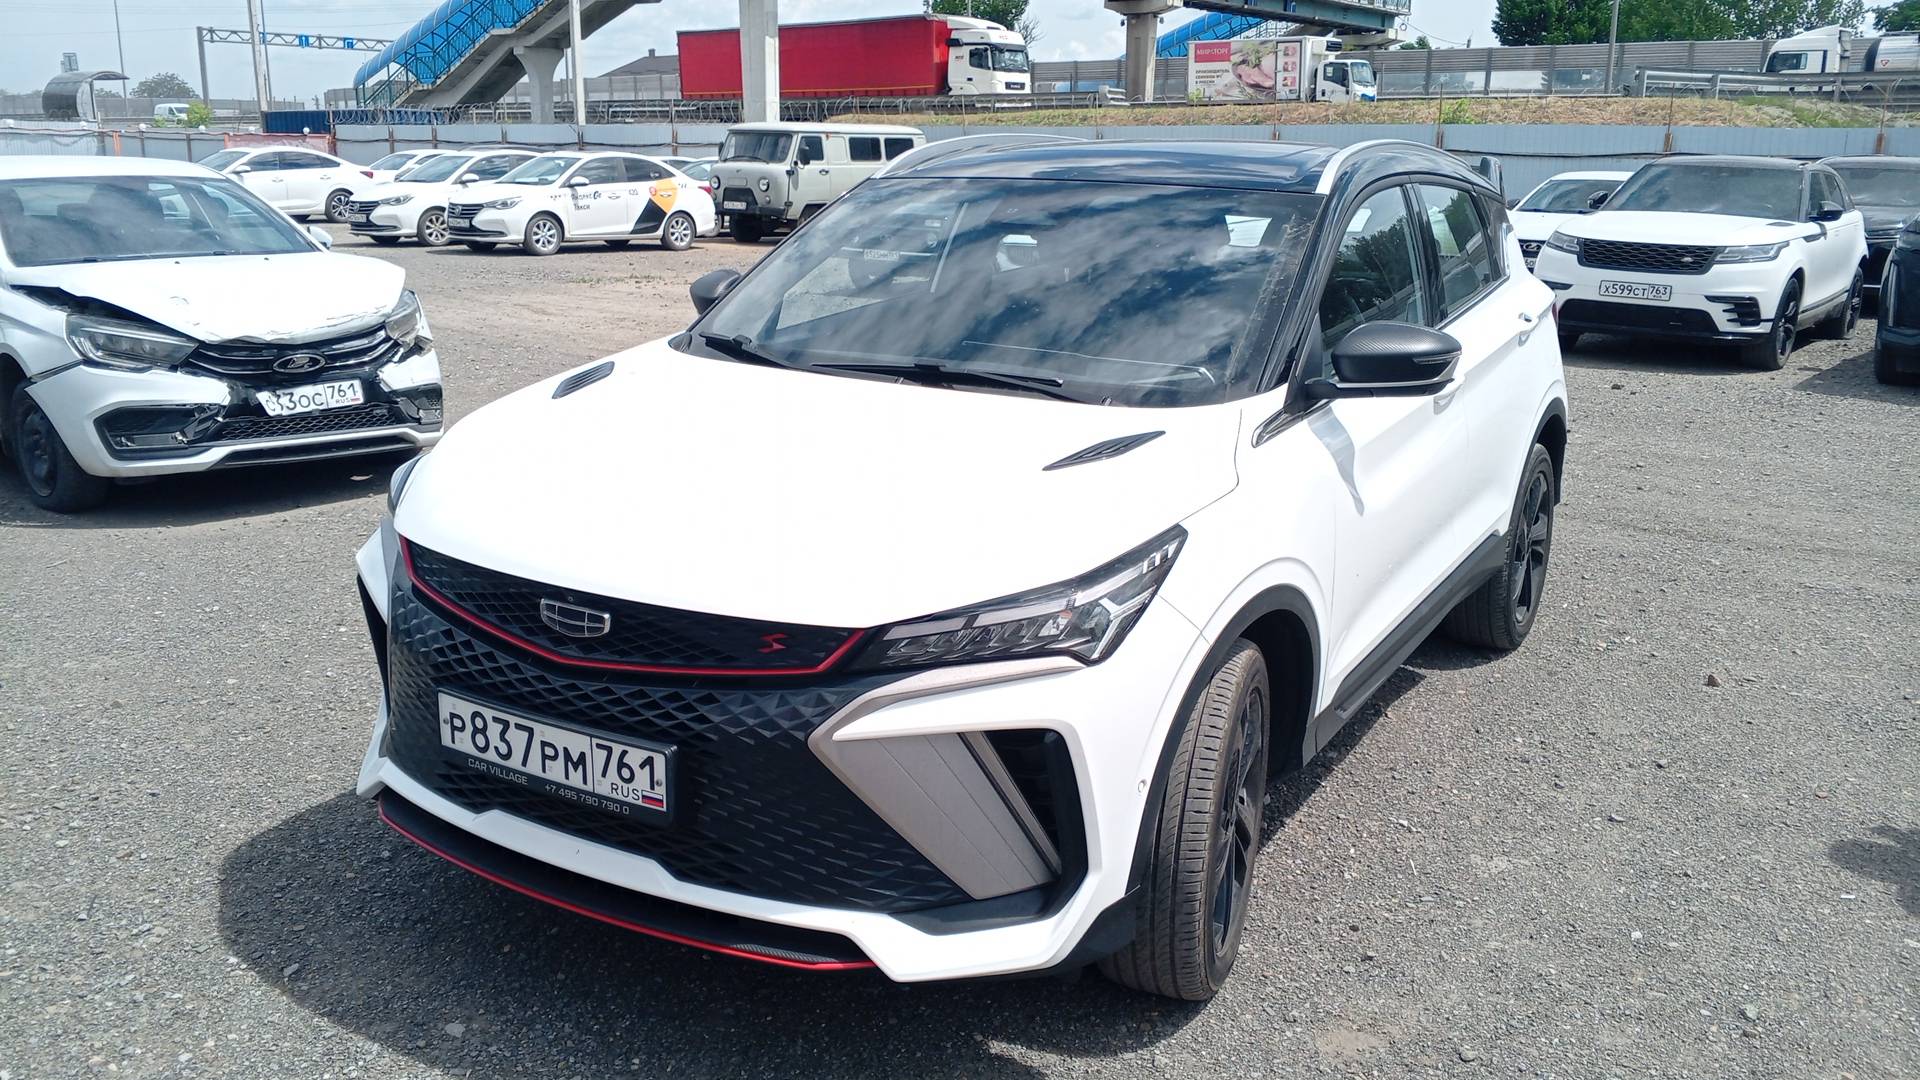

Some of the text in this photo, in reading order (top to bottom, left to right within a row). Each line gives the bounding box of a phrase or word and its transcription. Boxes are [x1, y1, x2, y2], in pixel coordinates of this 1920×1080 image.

[1650, 285, 1668, 296] 763
[326, 382, 358, 400] 761
[467, 758, 529, 786] CAR VILLAGE
[595, 742, 656, 791] 761
[544, 783, 556, 794] +7
[558, 788, 578, 800] 495
[579, 793, 599, 807] 790
[601, 800, 621, 813] 790
[610, 782, 641, 801] RUS
